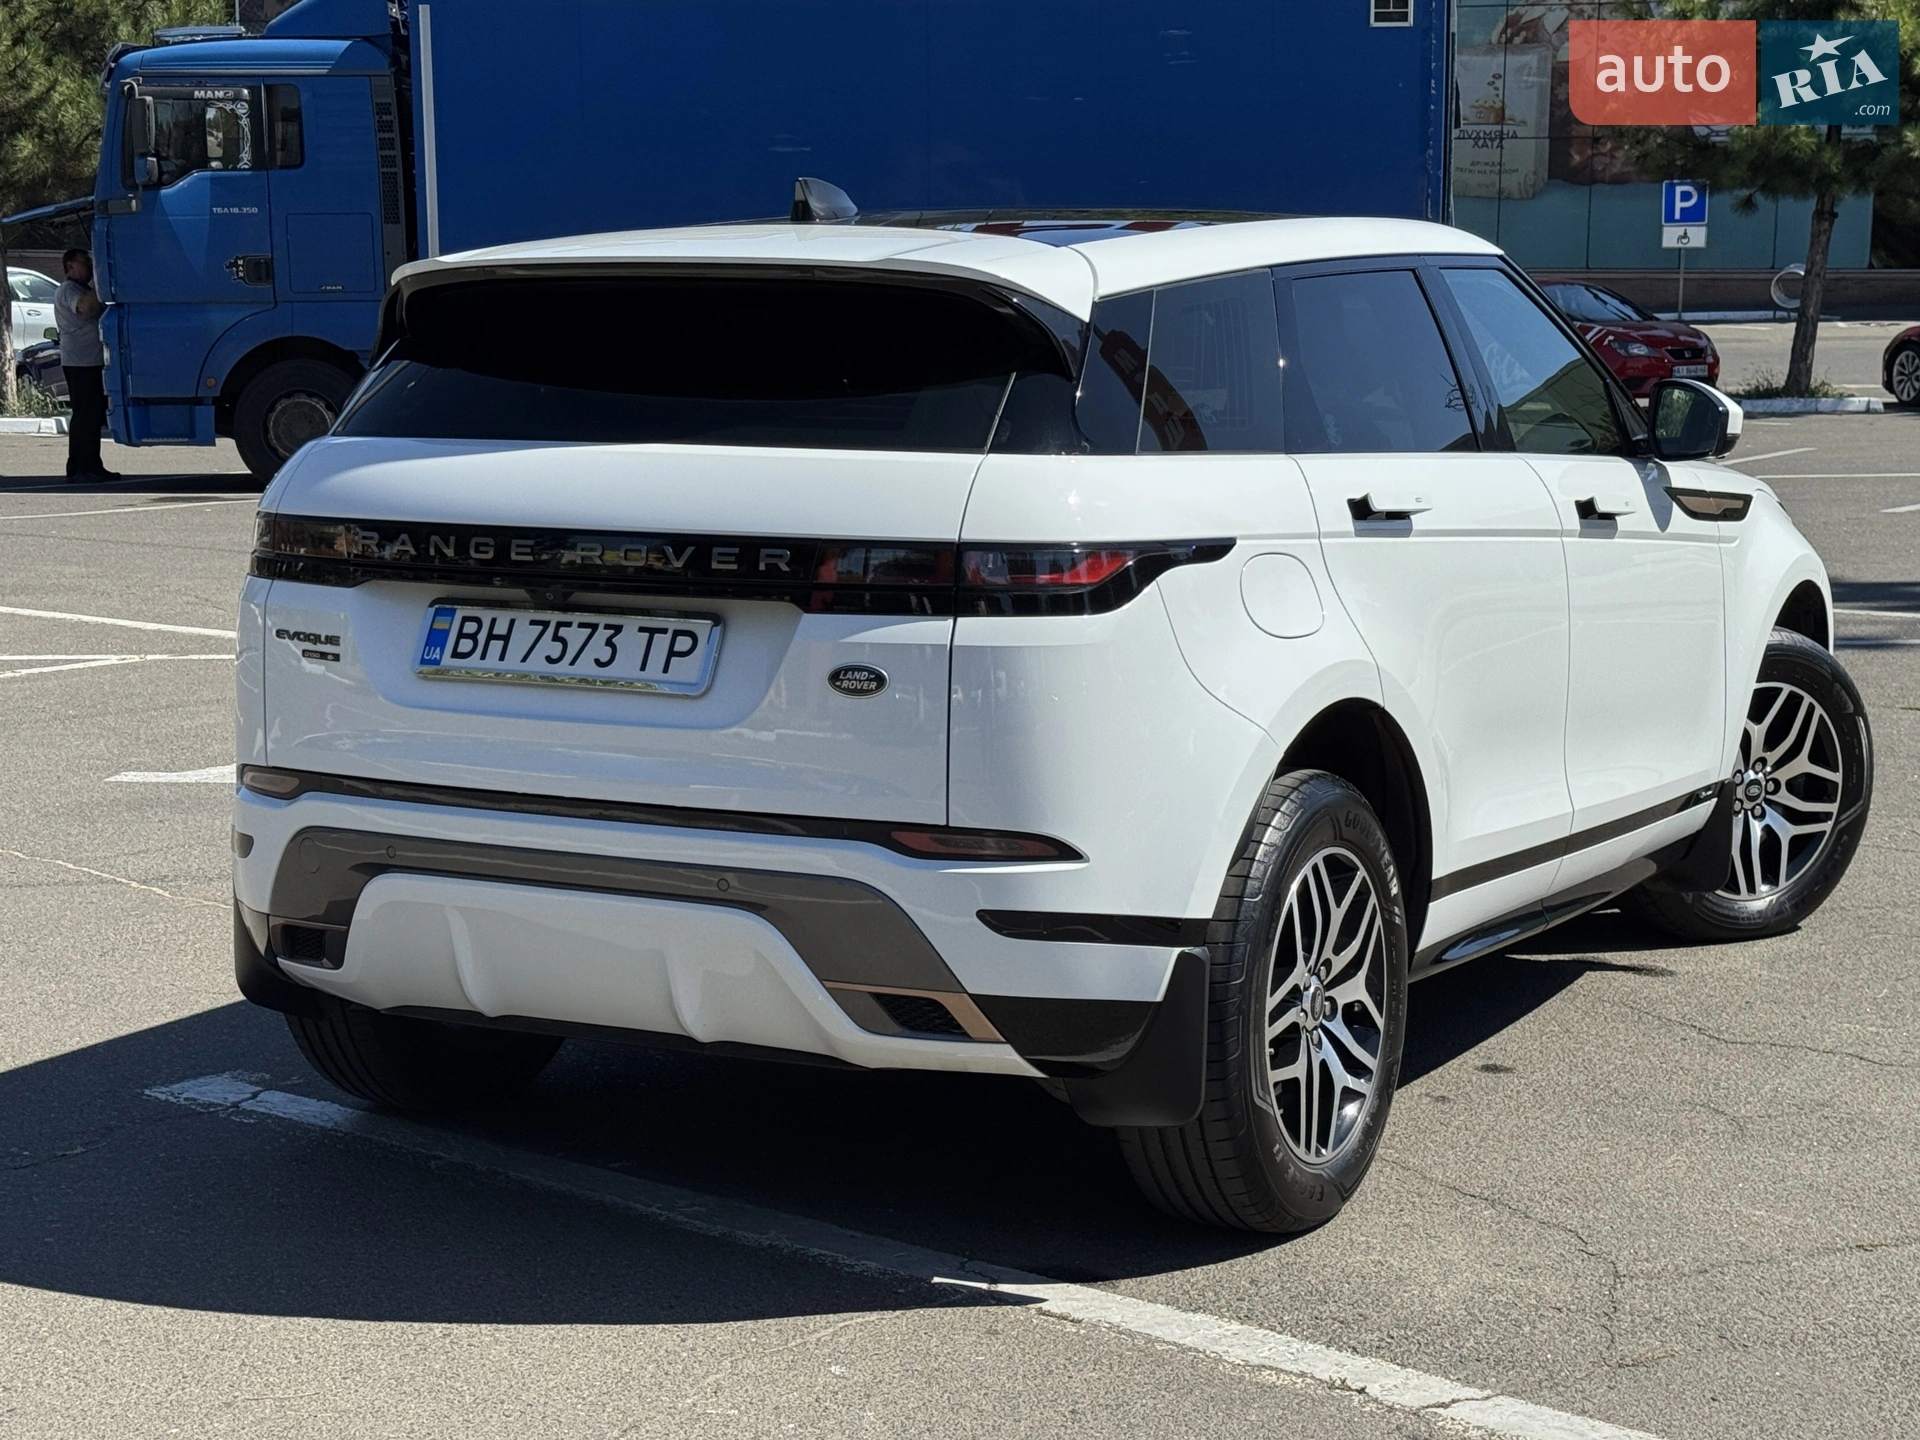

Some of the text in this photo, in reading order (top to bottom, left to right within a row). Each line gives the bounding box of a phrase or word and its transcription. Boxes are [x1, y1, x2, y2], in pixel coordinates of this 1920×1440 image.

[193, 90, 223, 99] MAN
[1472, 139, 1504, 149] ХАТА
[1674, 185, 1698, 220] P
[354, 531, 791, 571] RANGE ROVER
[275, 628, 341, 646] EVOQUE
[450, 615, 699, 674] BH 7573 TP
[423, 646, 441, 660] UA
